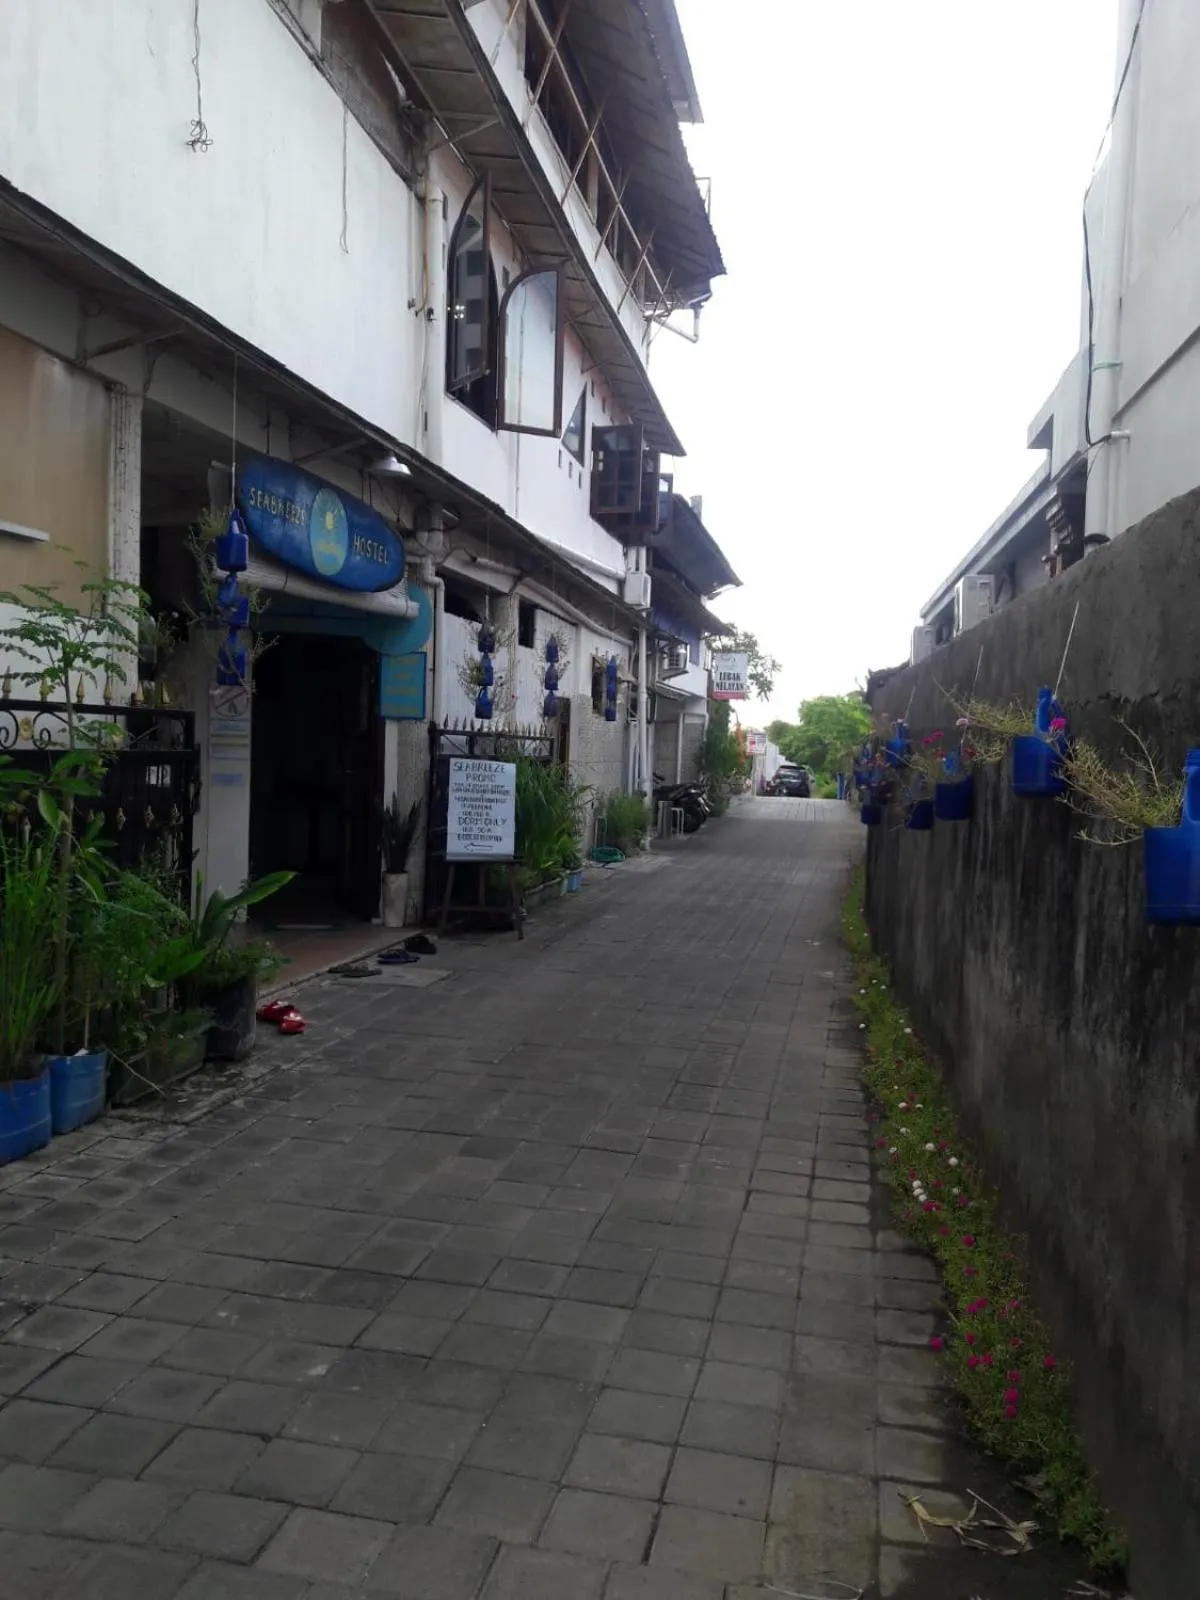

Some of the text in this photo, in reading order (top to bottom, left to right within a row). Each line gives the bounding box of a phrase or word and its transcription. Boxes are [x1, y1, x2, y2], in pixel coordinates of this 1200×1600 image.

[353, 533, 389, 565] HOSTEL
[719, 672, 741, 681] LEBAK
[465, 773, 496, 783] PROMO
